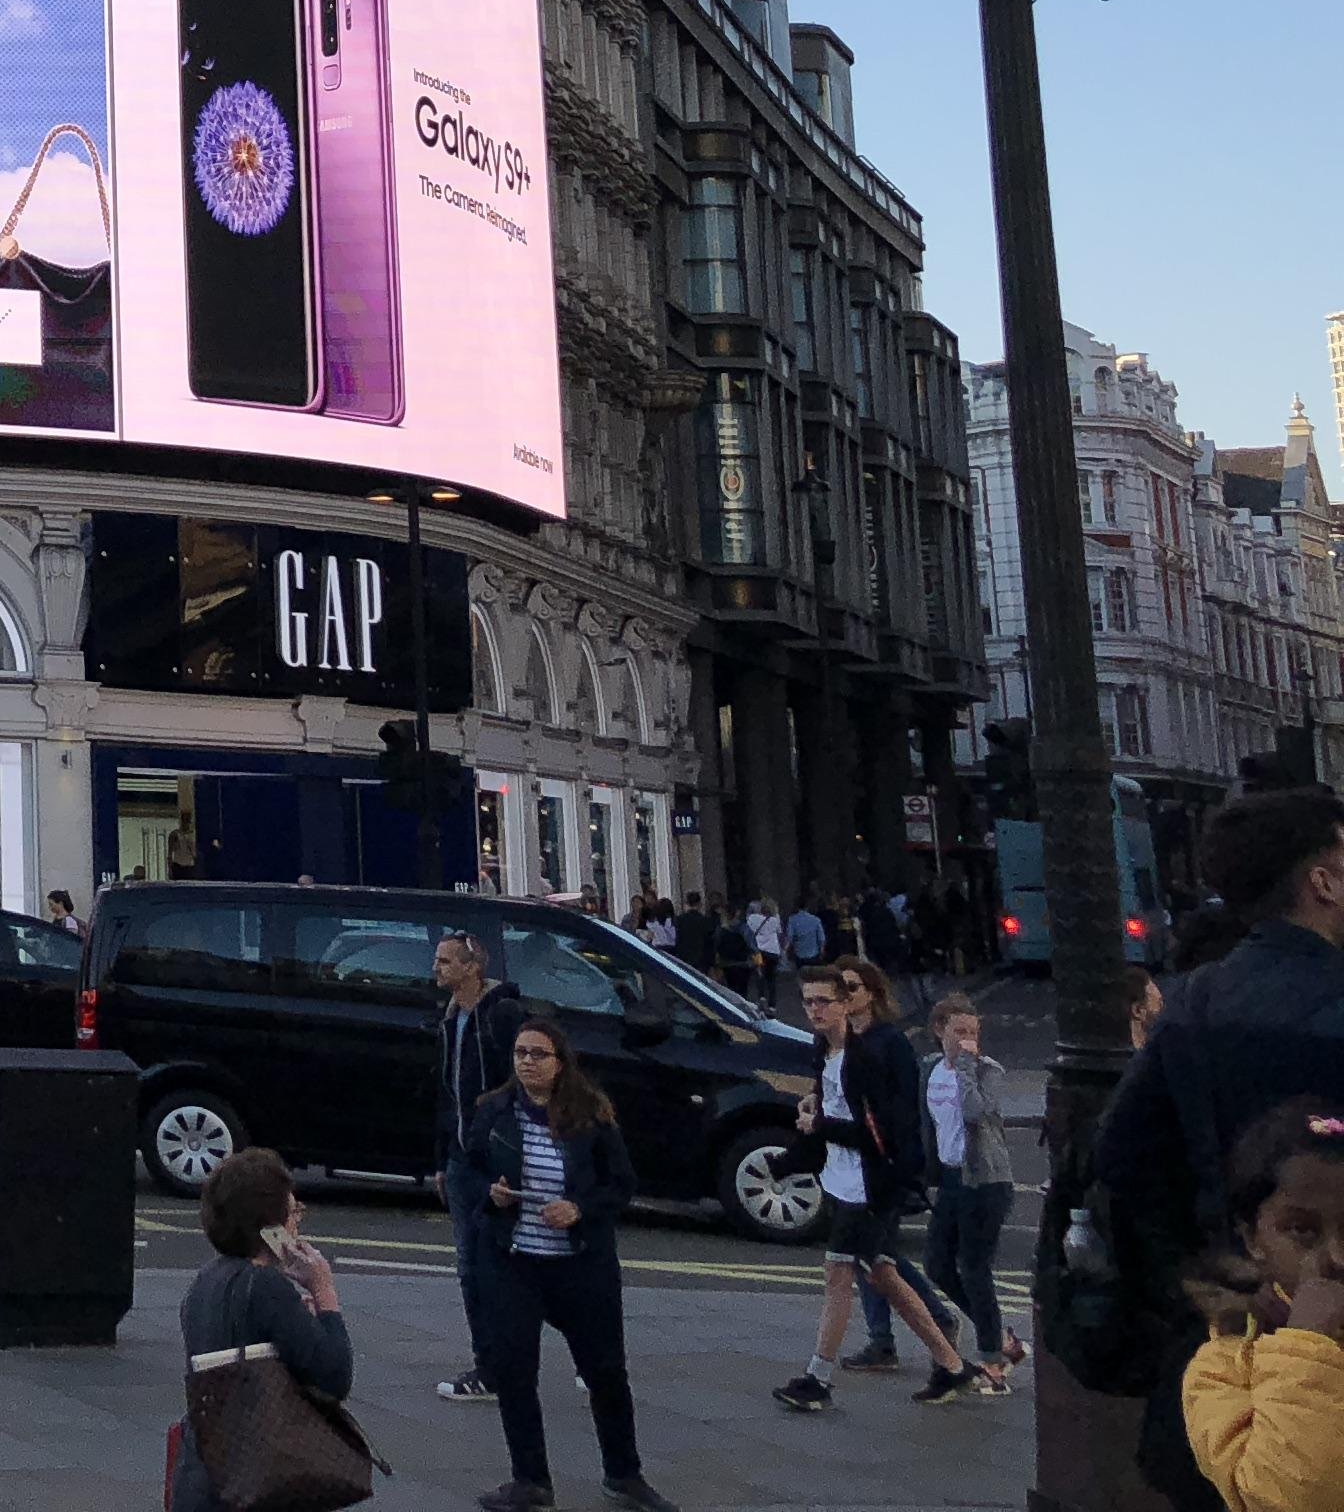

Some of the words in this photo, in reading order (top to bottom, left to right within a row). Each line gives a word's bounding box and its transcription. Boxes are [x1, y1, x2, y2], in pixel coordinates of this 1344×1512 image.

[413, 67, 460, 105] Introducing
[414, 95, 502, 195] Galaxy
[504, 140, 532, 196] S9+
[418, 174, 443, 201] The
[443, 184, 486, 221] Camera.
[276, 549, 382, 672] GAP
